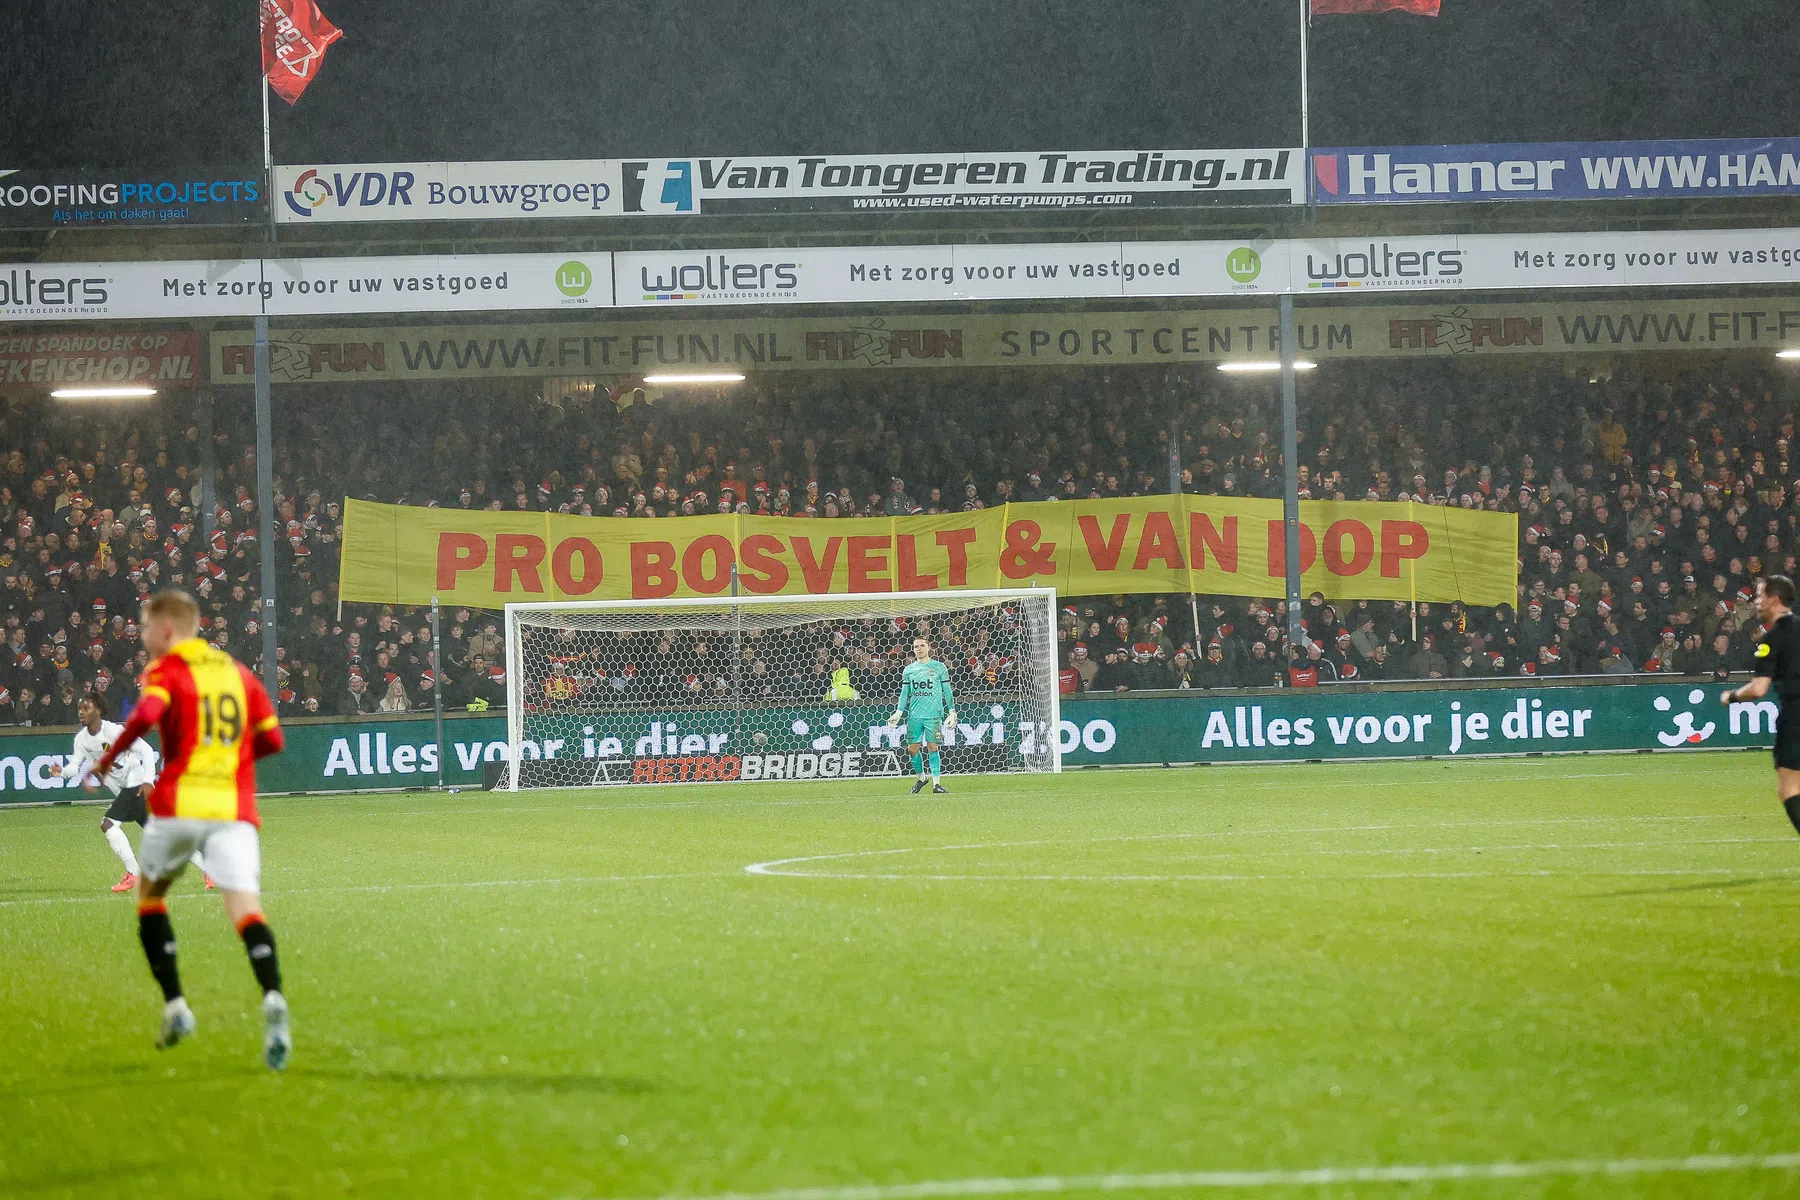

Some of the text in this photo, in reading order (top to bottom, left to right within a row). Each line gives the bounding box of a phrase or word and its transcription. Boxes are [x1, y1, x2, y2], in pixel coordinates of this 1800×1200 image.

[699, 150, 1290, 194] Van Tongeren Trading.nl
[1348, 153, 1800, 195] Hamer WWW.HAM
[333, 171, 610, 211] VDR Bouwgroep
[853, 192, 1132, 208] www.used-waterpumps.com
[53, 207, 189, 221] Als het om daken gaat!
[641, 255, 798, 292] wolters
[850, 258, 1180, 284] Met zorg voor uw vastgoed
[1307, 243, 1463, 279] wolters
[1514, 250, 1555, 268] Met
[1564, 252, 1616, 270] zorg
[1625, 251, 1677, 266] voor
[1686, 250, 1719, 265] uw
[163, 271, 508, 300] Met zorg voor uw vastgoed
[1365, 278, 1463, 286] VASTGOEDONDERHOUD
[36, 335, 137, 353] SPANDOEK
[140, 335, 168, 351] OP
[806, 329, 963, 361] FIT FUN
[1389, 316, 1543, 349] FIT FUN
[222, 342, 386, 374] FI FUN
[400, 332, 792, 370] WWW.FIT-FUN.NL
[436, 511, 1430, 599] PRO BOSVELT & VAN DOP
[912, 679, 934, 690] bet
[202, 692, 241, 746] 19
[869, 704, 1004, 749] mxi
[1201, 698, 1593, 754] Alles voor je dier
[323, 731, 440, 777] Alles
[454, 738, 565, 771] voor
[635, 722, 728, 756] dier
